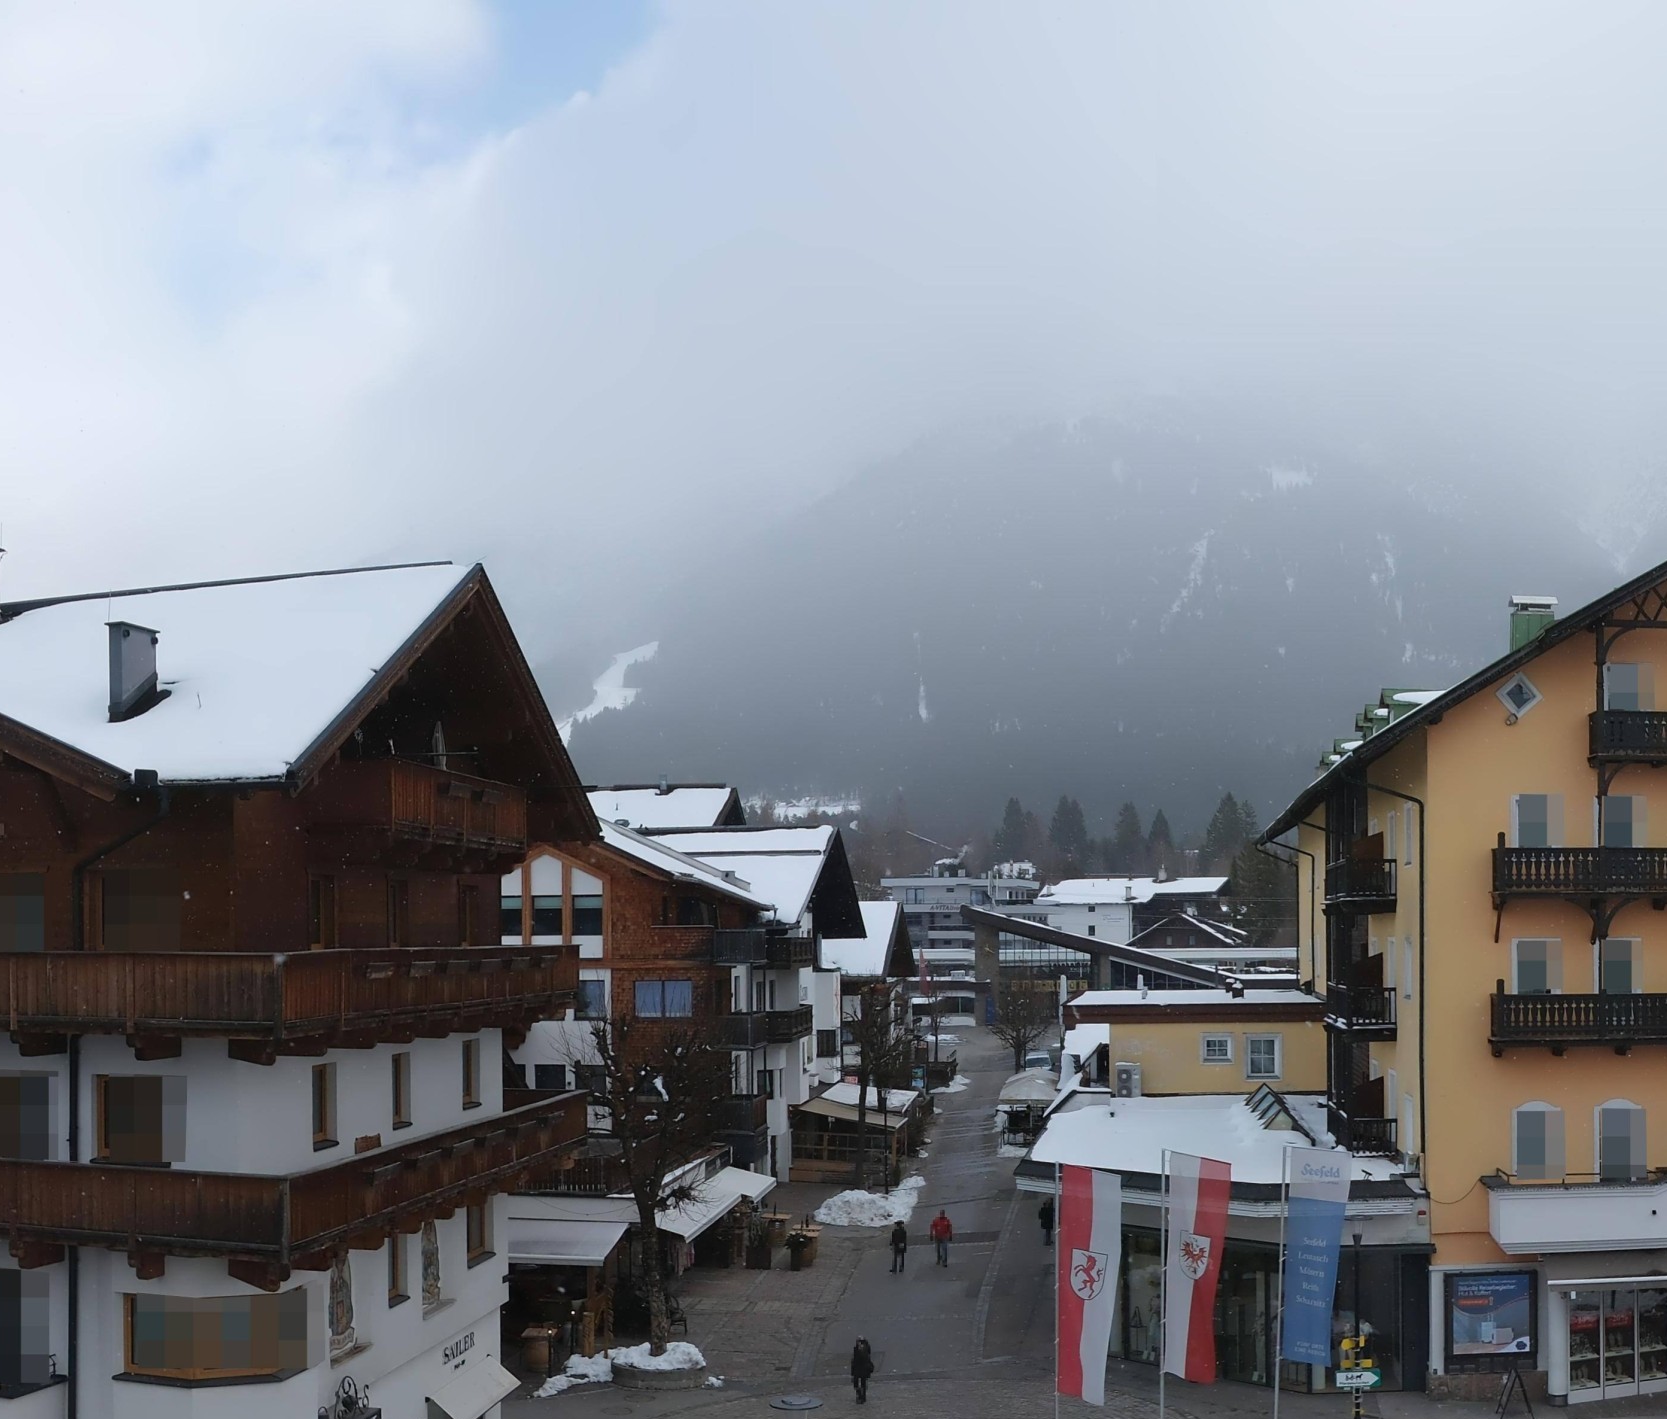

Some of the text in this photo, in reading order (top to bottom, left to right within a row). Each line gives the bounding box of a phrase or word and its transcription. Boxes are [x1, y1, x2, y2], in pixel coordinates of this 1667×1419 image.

[1301, 1163, 1341, 1178] Seefeld
[1303, 1236, 1327, 1248] Seefeld
[1298, 1251, 1329, 1263] Leutasch
[1299, 1265, 1325, 1278] Mösern
[1302, 1281, 1320, 1292] Reith
[1295, 1294, 1327, 1308] Scharnitz
[442, 1331, 475, 1365] SAILER
